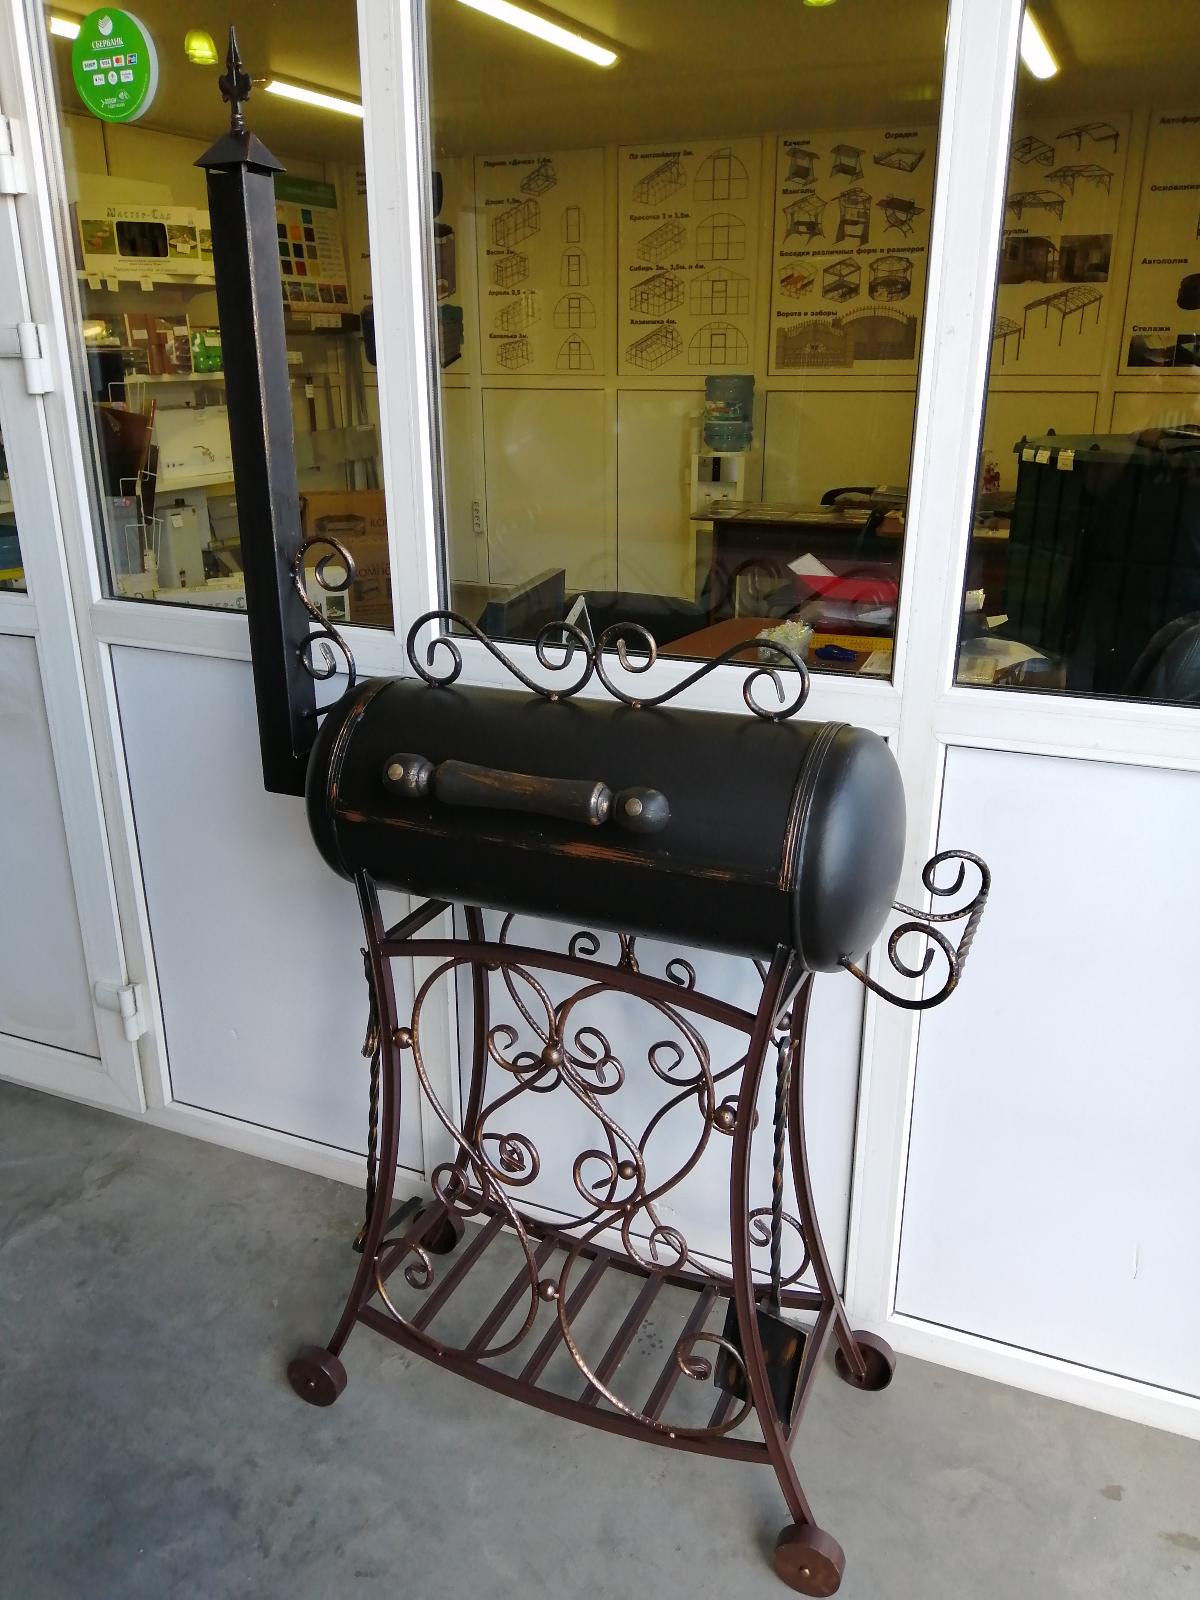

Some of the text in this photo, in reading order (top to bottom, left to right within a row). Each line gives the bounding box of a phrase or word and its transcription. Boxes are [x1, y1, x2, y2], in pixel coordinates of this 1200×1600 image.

[91, 37, 124, 49] СБЕРБАНК
[885, 132, 918, 140] Оградки
[812, 248, 854, 257] различных
[856, 247, 878, 255] форм
[886, 246, 925, 254] размеров
[1141, 257, 1189, 265] Автополив
[776, 310, 802, 318] Ворота
[810, 309, 838, 317] заборы
